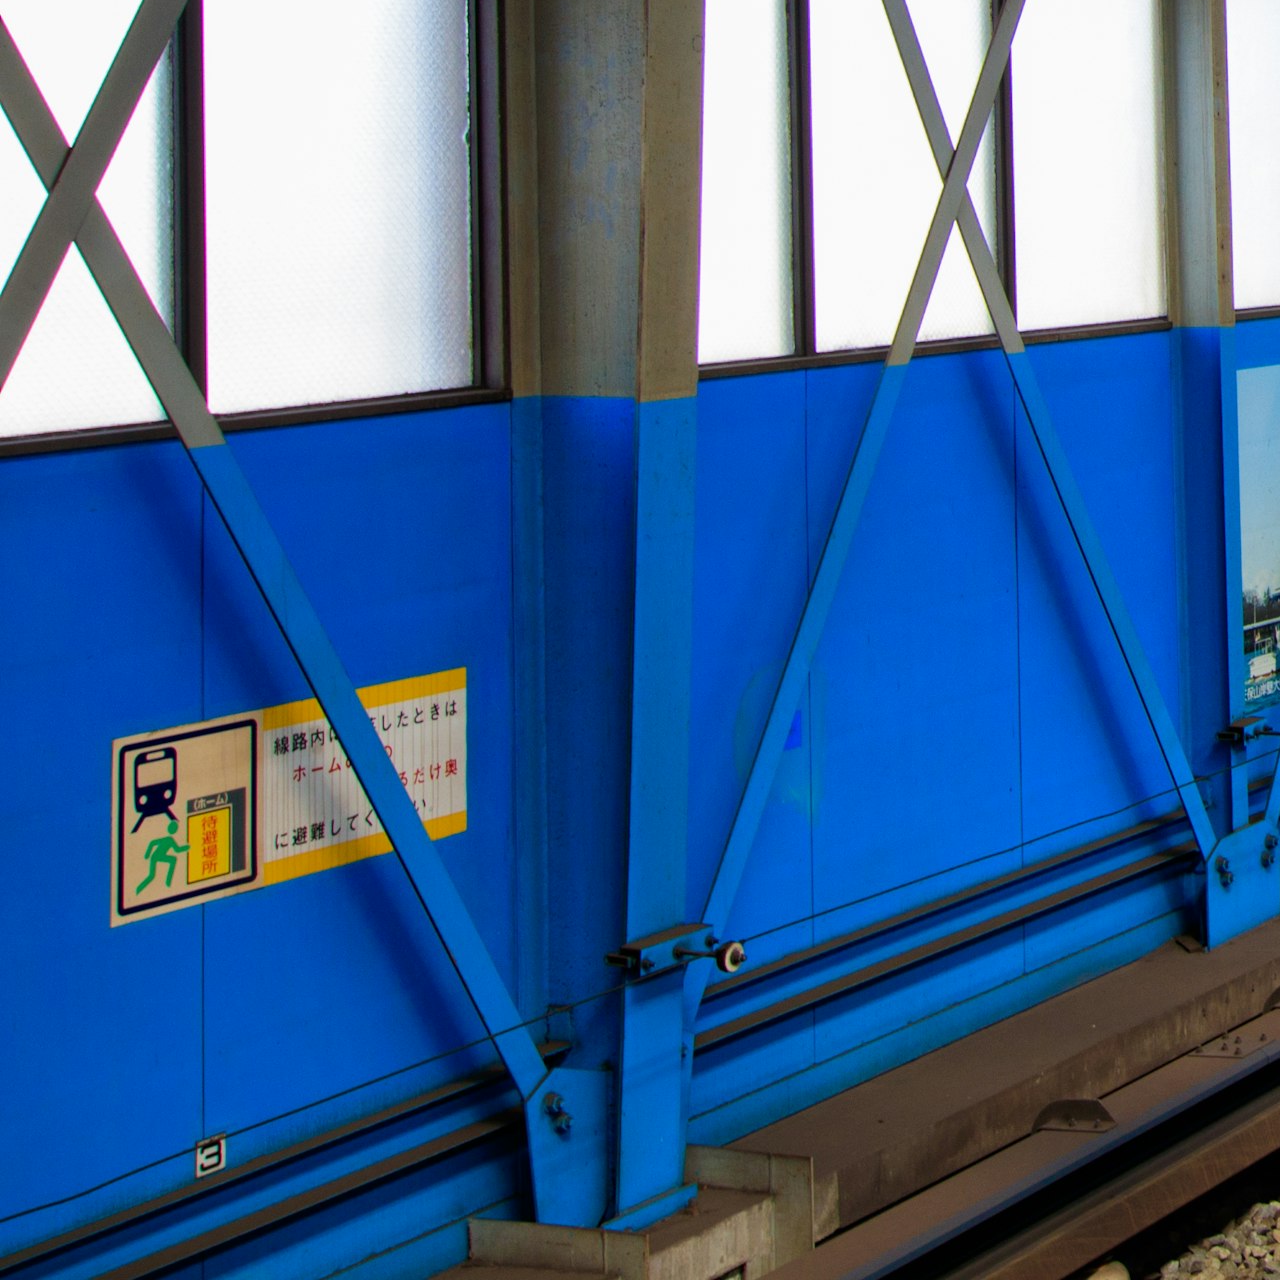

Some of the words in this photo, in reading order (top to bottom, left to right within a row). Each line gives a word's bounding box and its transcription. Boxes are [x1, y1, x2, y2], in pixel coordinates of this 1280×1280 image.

[201, 815, 218, 876] 待避場所
[200, 1139, 222, 1172] 3
